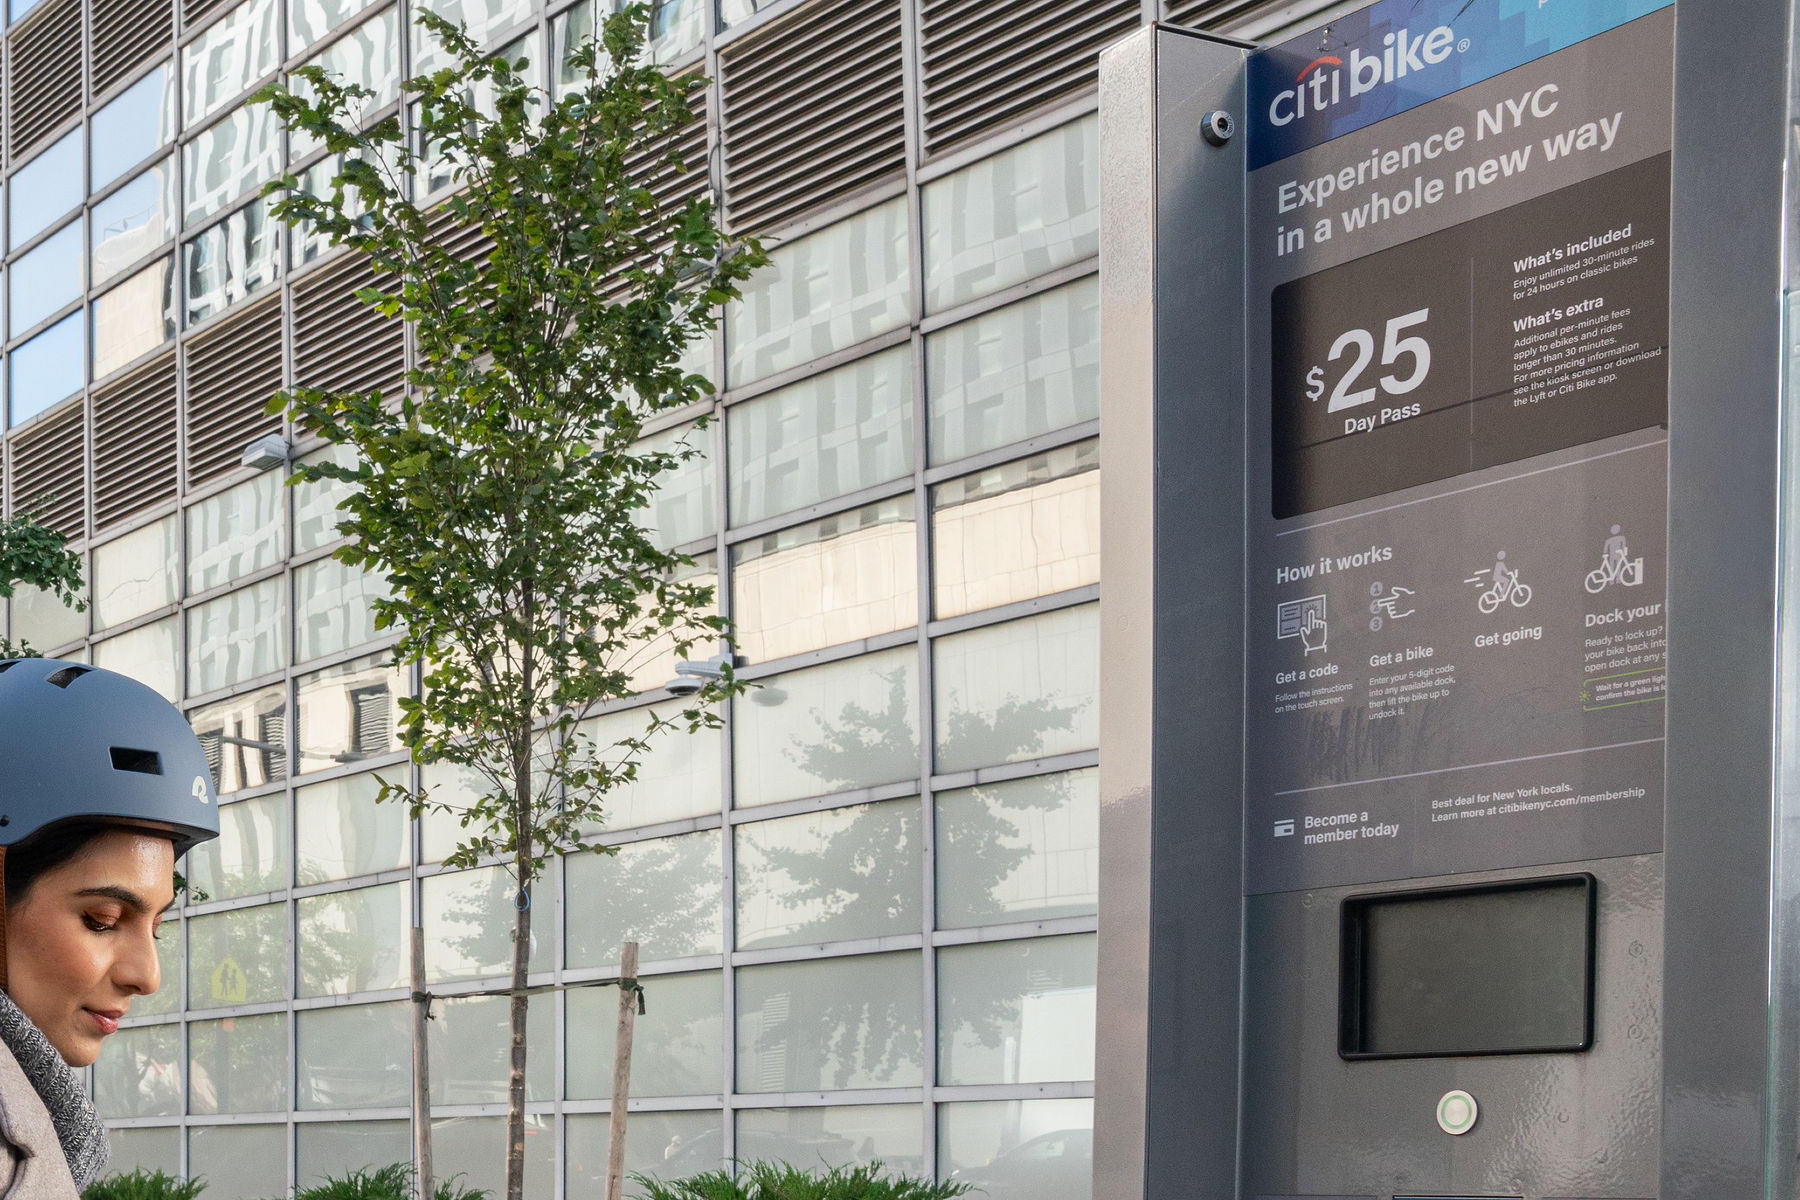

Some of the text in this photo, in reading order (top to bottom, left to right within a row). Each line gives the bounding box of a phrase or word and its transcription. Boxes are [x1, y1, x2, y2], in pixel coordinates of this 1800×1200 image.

[1269, 56, 1342, 127] citi
[1278, 83, 1558, 214] Experience NYC
[1277, 111, 1622, 256] in a whole new way
[1513, 223, 1631, 273] What's included
[1513, 238, 1654, 288] Enjoy unlimited 30-minute rides
[1512, 255, 1638, 300] for 24 hours on classic bikes
[1513, 297, 1603, 332] What's extra
[1305, 307, 1432, 414] $25
[1344, 402, 1420, 434] Day Pass
[1277, 546, 1392, 584] How it works
[1585, 603, 1661, 627] Dock your
[1474, 626, 1542, 647] Get going
[1275, 662, 1338, 684] Get a code
[1369, 645, 1433, 667] Get a bike
[1431, 783, 1573, 809] Best deal for New York locals.
[1431, 788, 1645, 822] Learn more at citibikenyc.com/membership
[1304, 811, 1368, 828] Become a
[1304, 822, 1399, 844] member today
